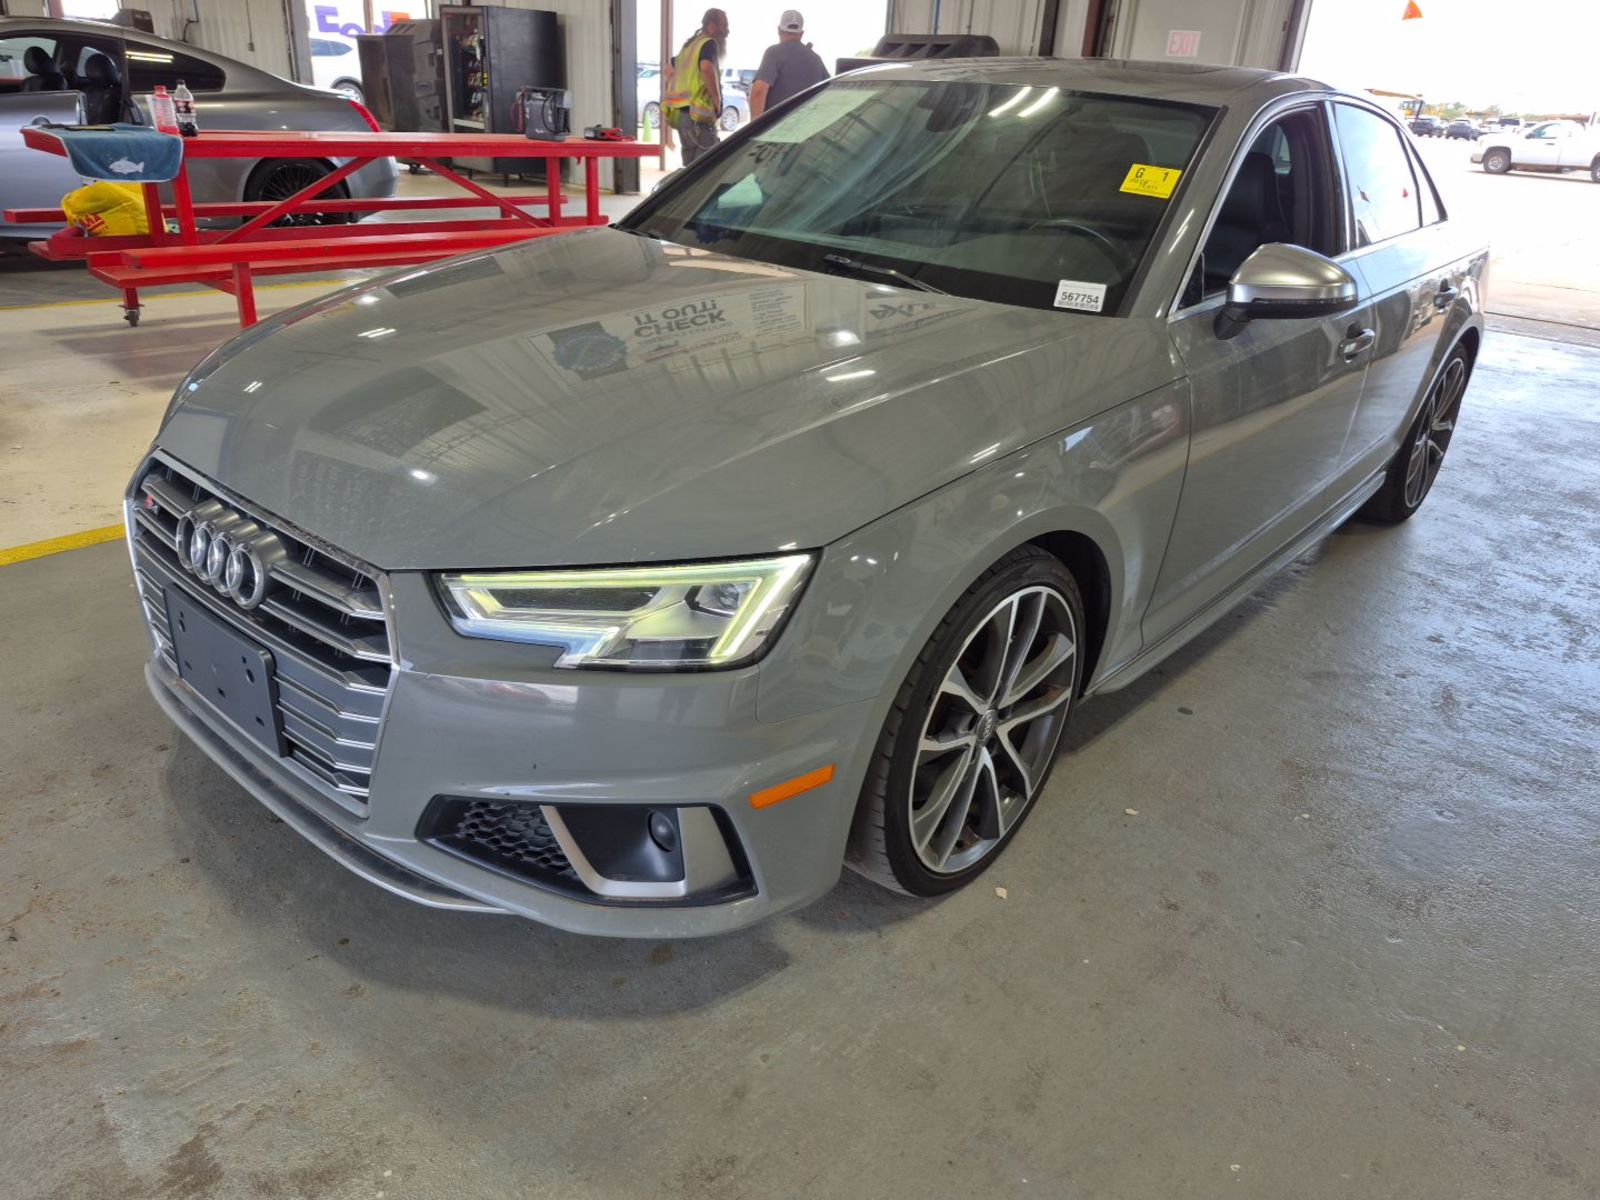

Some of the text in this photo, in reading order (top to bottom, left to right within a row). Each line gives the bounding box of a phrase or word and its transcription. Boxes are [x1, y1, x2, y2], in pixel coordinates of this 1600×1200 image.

[1168, 31, 1197, 55] EXIT
[1135, 167, 1170, 183] G 1
[1061, 291, 1099, 304] 567754
